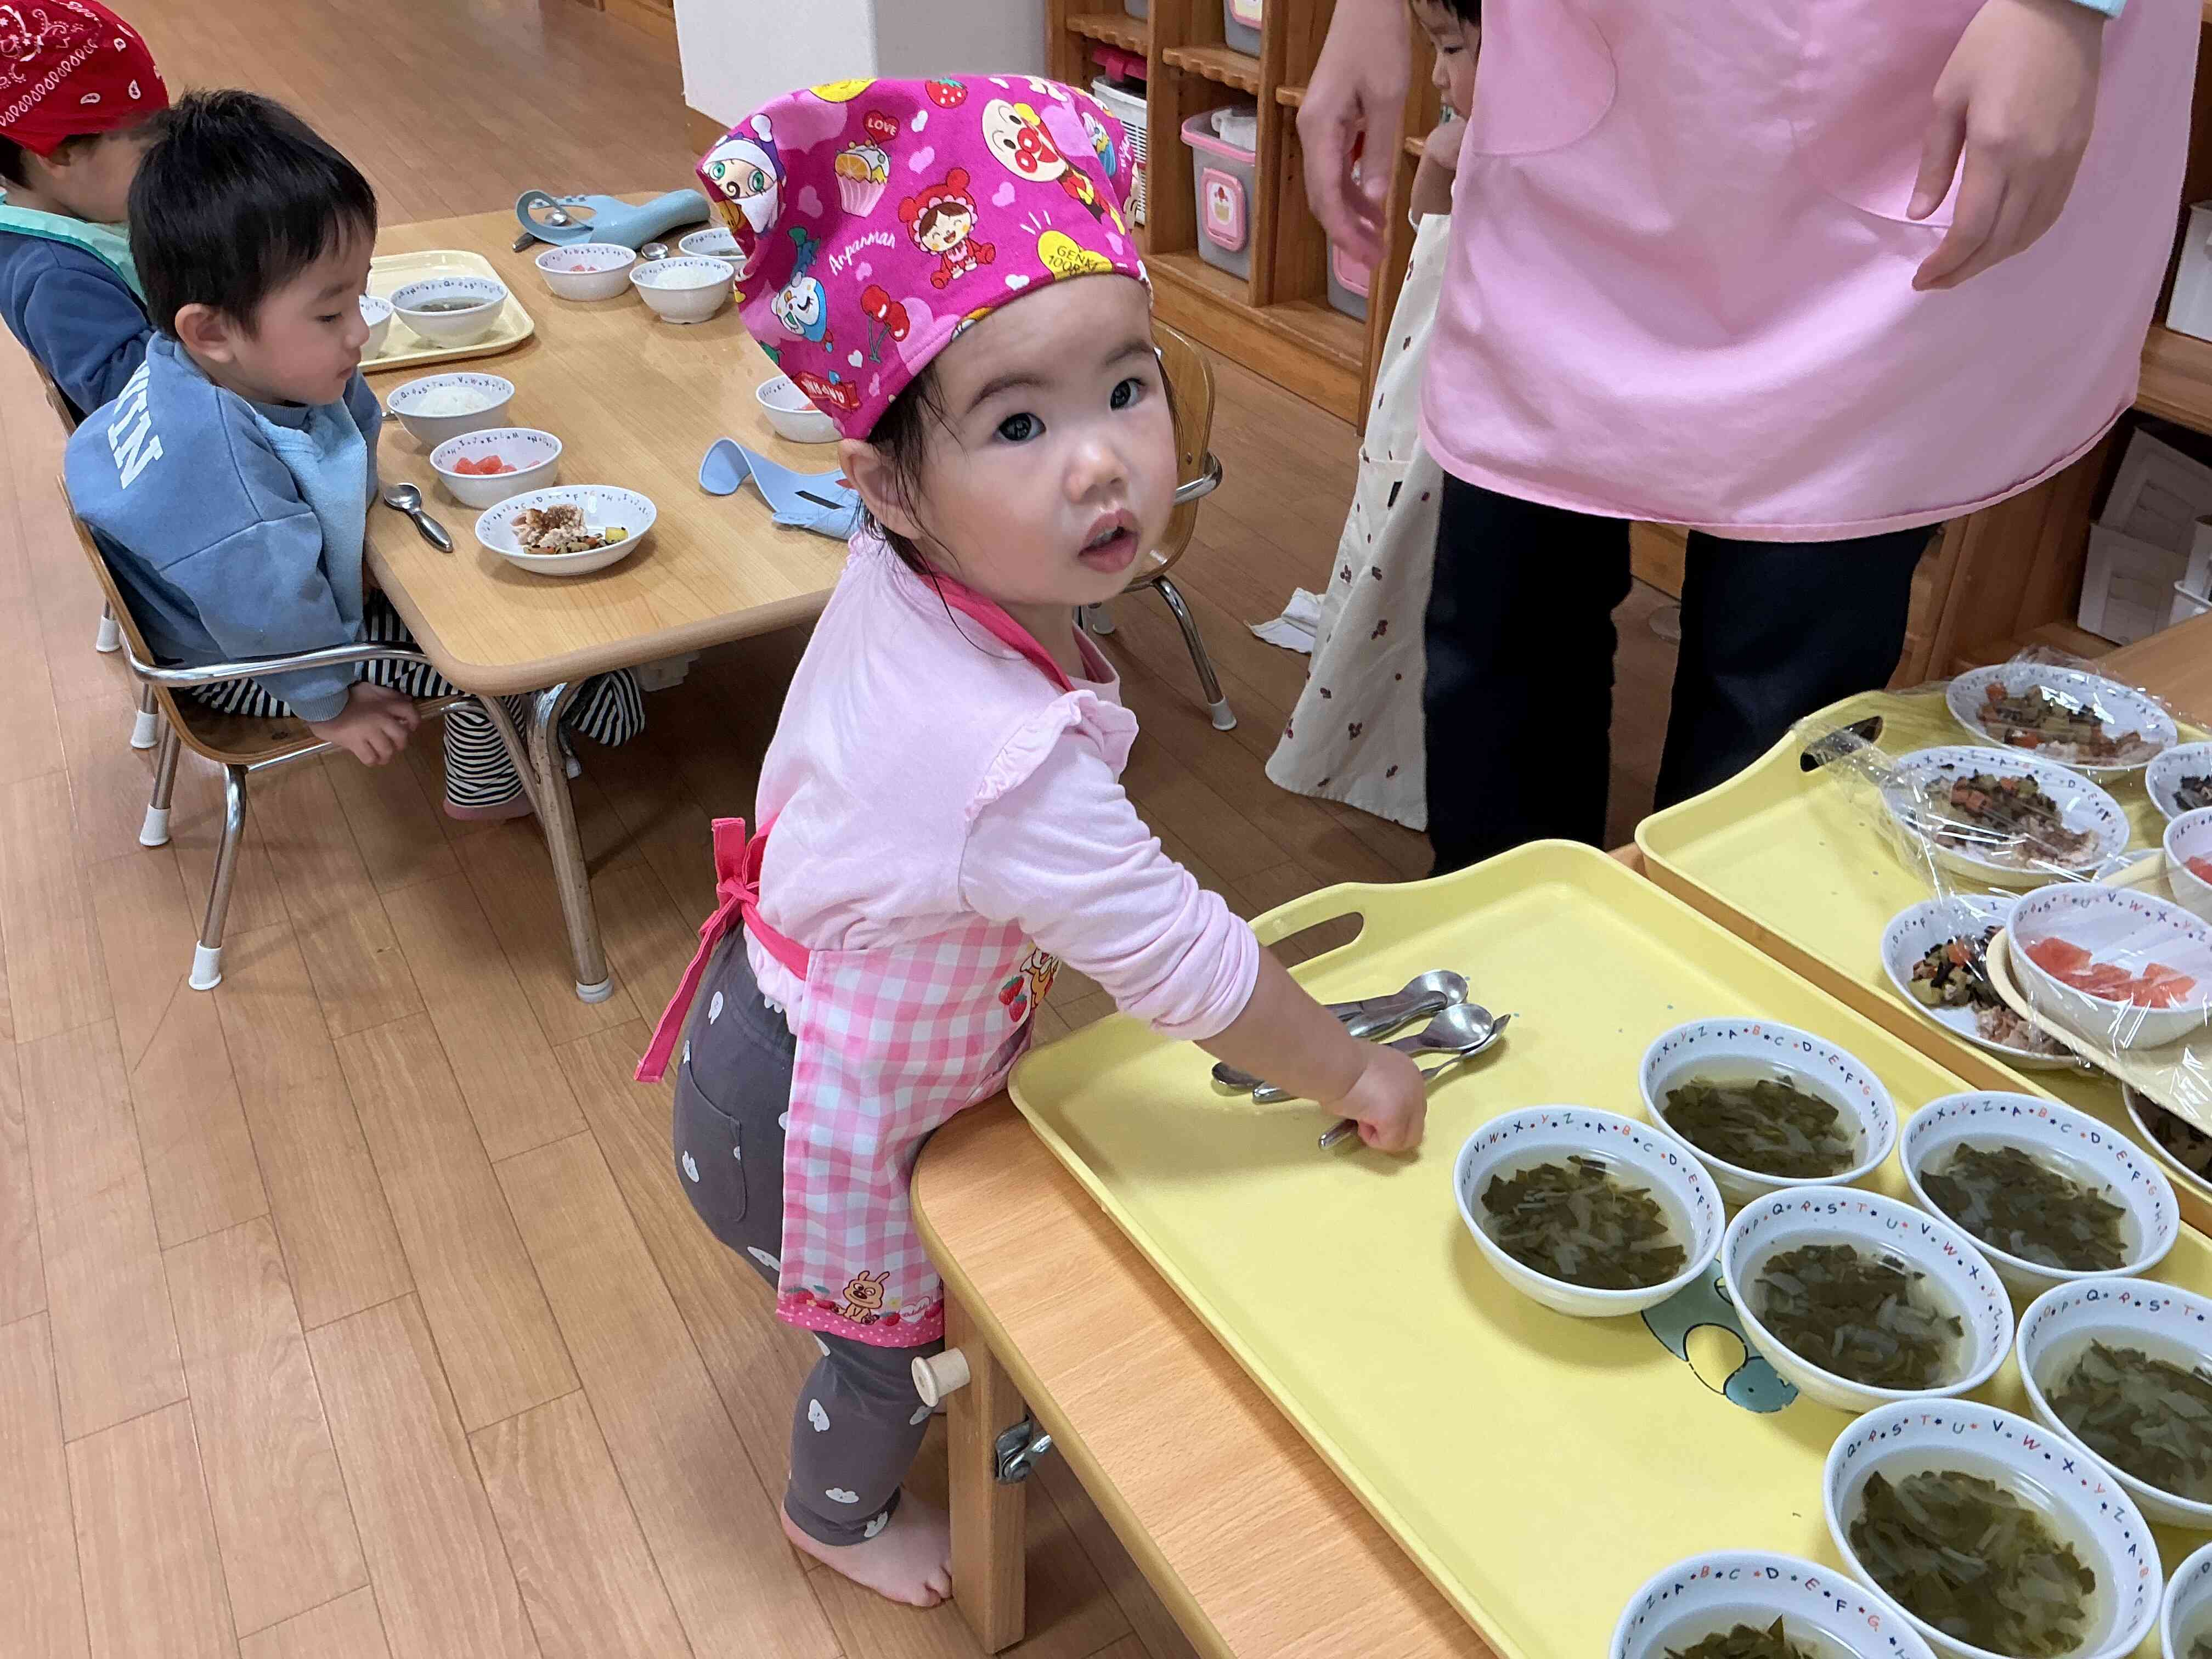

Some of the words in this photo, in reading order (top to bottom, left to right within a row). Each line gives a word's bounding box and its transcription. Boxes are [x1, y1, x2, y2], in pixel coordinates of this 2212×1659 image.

[867, 117, 897, 137] LOVE
[828, 230, 896, 276] Anpanman
[1663, 1043, 1669, 1055] X
[1681, 1032, 1686, 1042] Y
[1699, 1026, 1707, 1037] Z
[1729, 1030, 1737, 1039] A
[1752, 1025, 1760, 1035] B
[1774, 1037, 1784, 1046] C
[1803, 1041, 1811, 1051] D
[1829, 1054, 1839, 1064] E
[1846, 1073, 1853, 1082] F
[1475, 1142, 1479, 1152] V
[1490, 1132, 1498, 1144] W
[1514, 1121, 1523, 1133] X
[1542, 1115, 1548, 1124] Y
[1564, 1113, 1573, 1124] Z
[1598, 1123, 1606, 1133] A
[1622, 1125, 1630, 1136] B
[1644, 1143, 1653, 1152] C
[1670, 1154, 1677, 1165] D
[1689, 1173, 1697, 1183] E
[1697, 1195, 1704, 1205] F
[1938, 1108, 1945, 1120] X
[1960, 1102, 1970, 1112] Y
[1983, 1101, 1993, 1111] Z
[2013, 1107, 2021, 1116] A
[2038, 1108, 2047, 1118] B
[2061, 1124, 2072, 1132] C
[2091, 1133, 2100, 1143] D
[2117, 1150, 2127, 1161] E
[2132, 1171, 2140, 1181] F
[1773, 1204, 1784, 1215] Q
[1801, 1201, 1810, 1211] R
[1828, 1204, 1837, 1214] S
[1858, 1203, 1867, 1212] T
[1887, 1218, 1898, 1229] U
[1922, 1223, 1930, 1234] V
[1944, 1242, 1957, 1255] W
[1970, 1266, 1979, 1279] X
[2062, 1302, 2068, 1313] P
[2087, 1290, 2100, 1301] Q
[2119, 1293, 2130, 1303] R
[2150, 1300, 2159, 1311] S
[2185, 1305, 2194, 1316] T
[1848, 1444, 1856, 1457] Q
[1869, 1430, 1876, 1442] R
[1893, 1424, 1901, 1436] S
[1921, 1415, 1931, 1425] T
[1953, 1423, 1965, 1434] U
[1993, 1420, 2003, 1432] V
[2023, 1435, 2040, 1449] W
[2063, 1458, 2074, 1473] X
[2114, 1506, 2125, 1523] Z
[2129, 1544, 2136, 1557] A
[1675, 1584, 1684, 1595] A
[1701, 1566, 1709, 1578] B
[1729, 1569, 1740, 1579] C
[1766, 1567, 1779, 1579] D
[1805, 1578, 1820, 1590] E
[1837, 1600, 1846, 1612] F
[1868, 1615, 1880, 1632] G
